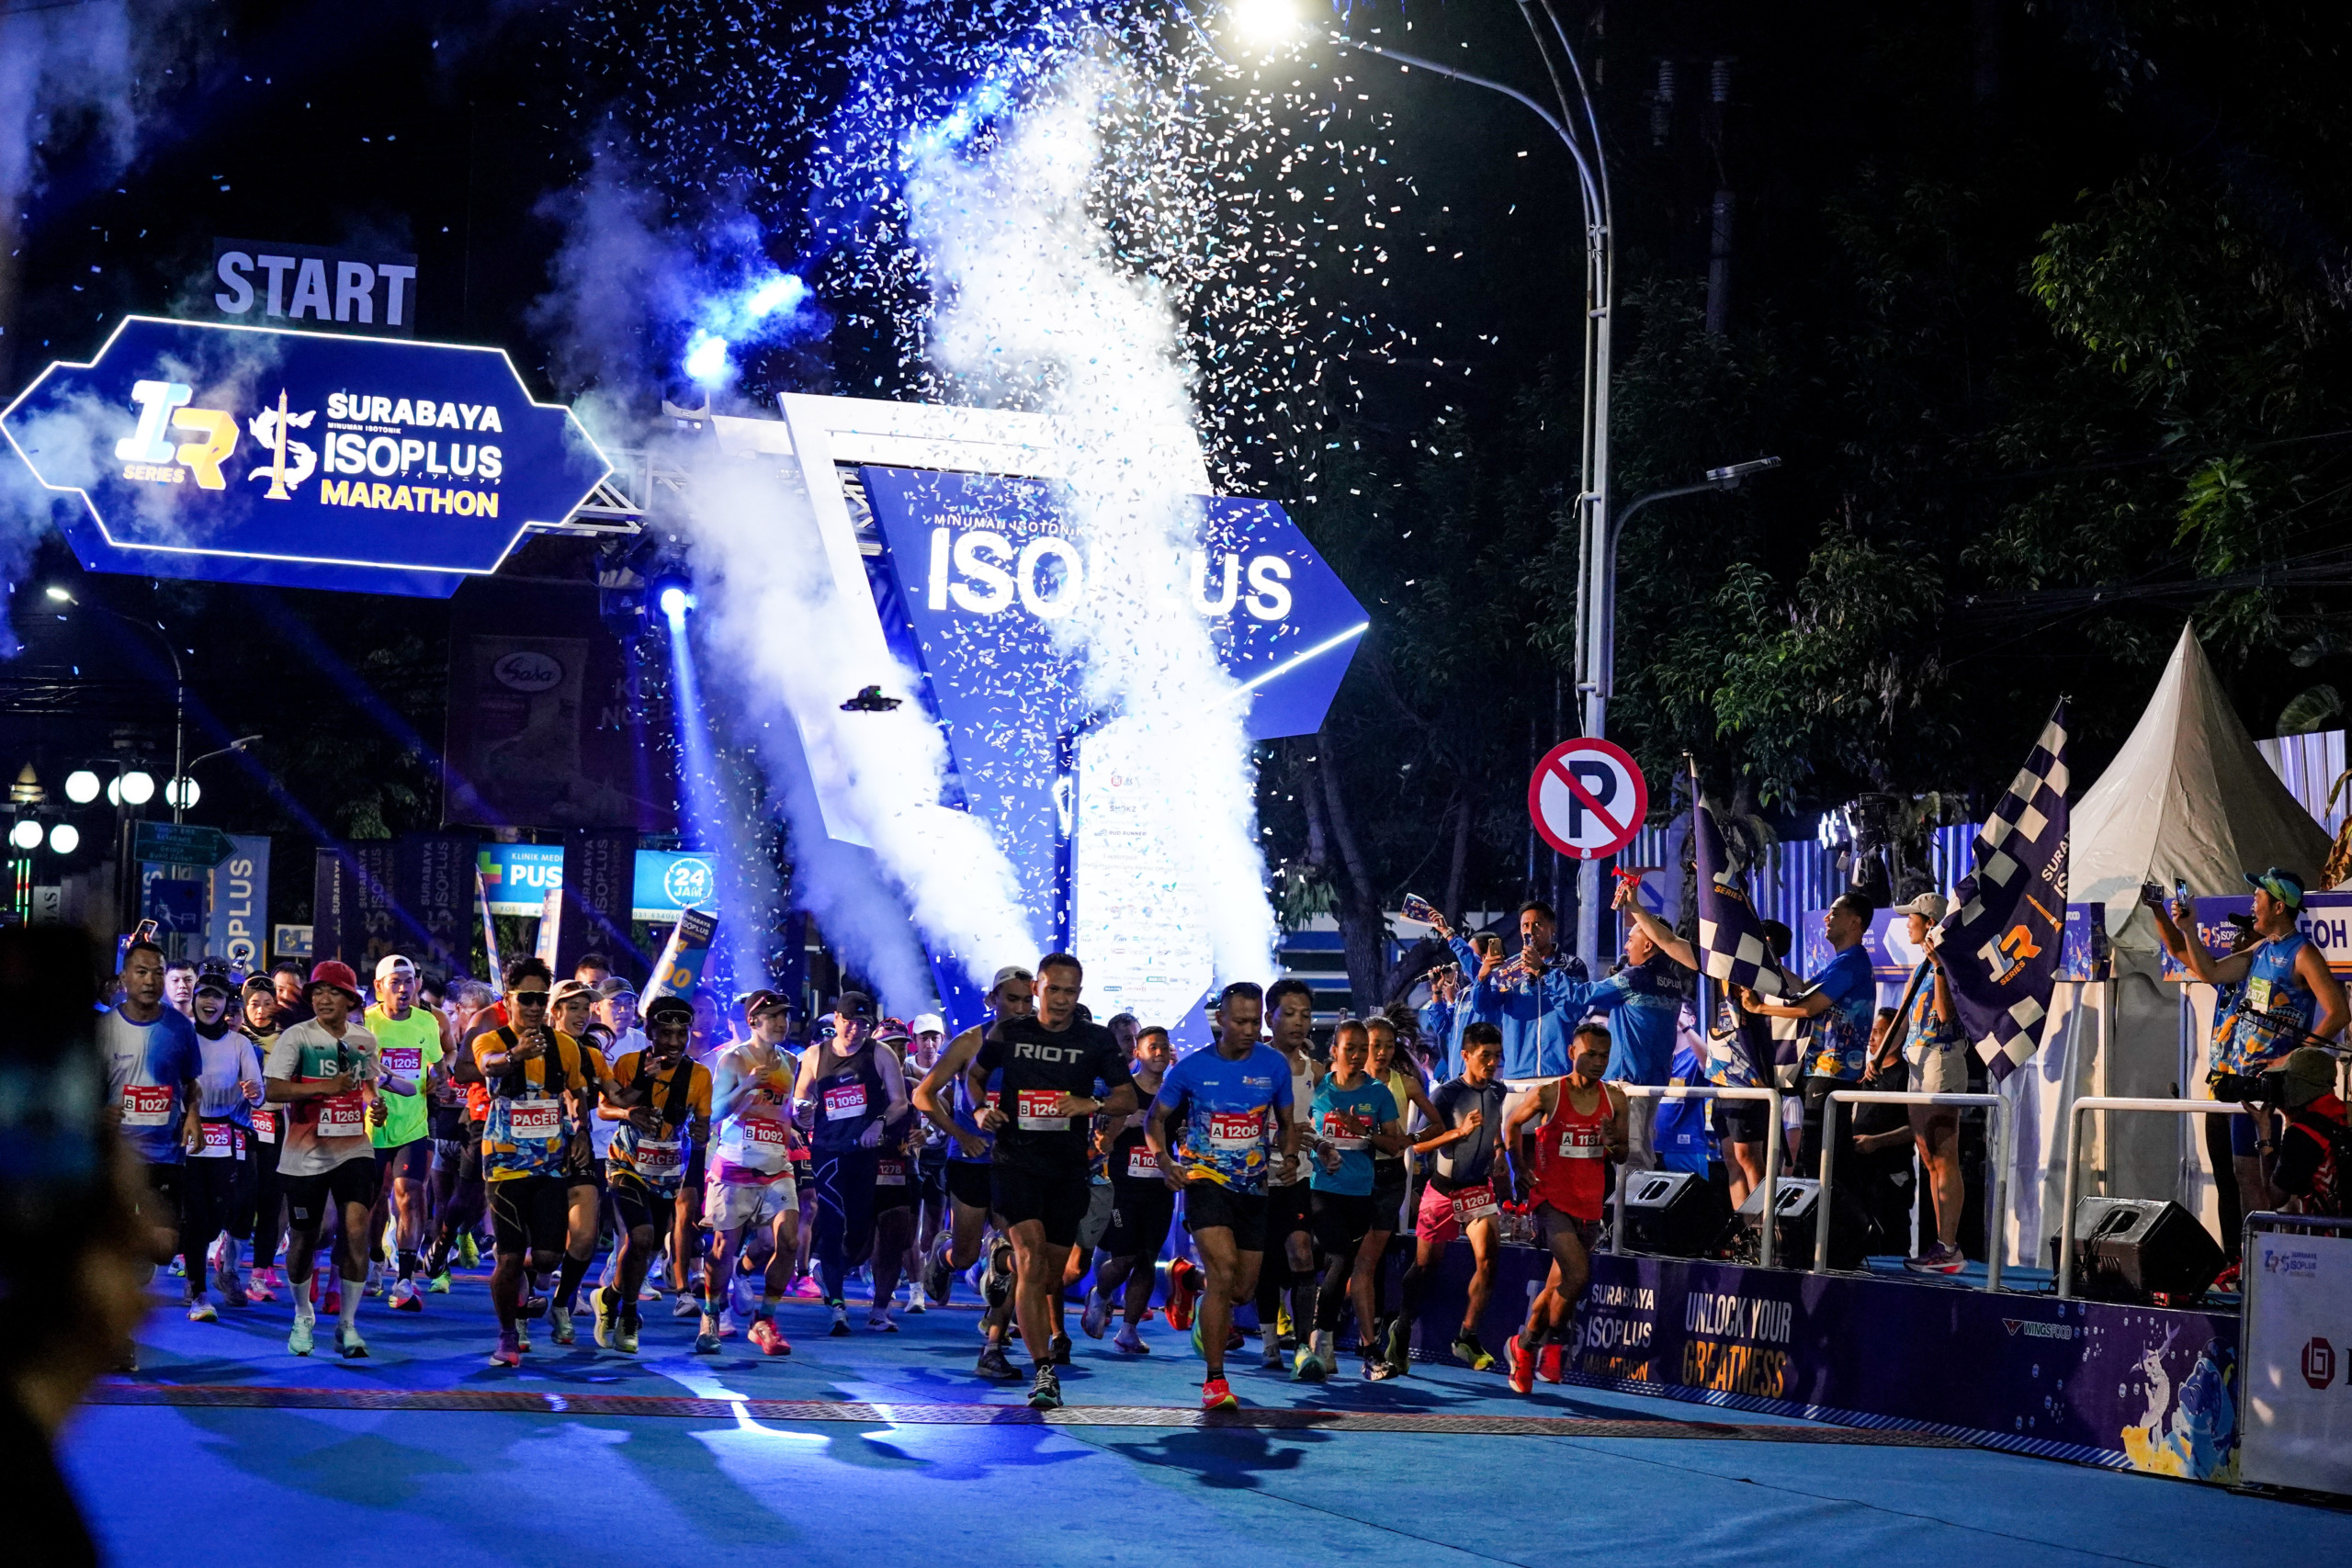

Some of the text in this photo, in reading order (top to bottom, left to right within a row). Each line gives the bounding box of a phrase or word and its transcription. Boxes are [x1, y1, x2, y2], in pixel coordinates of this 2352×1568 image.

[215, 251, 416, 326] START
[327, 392, 503, 433] SURABAYA
[327, 422, 401, 434] MINUMAN ISOTONIK
[323, 432, 503, 479] ISOPLUS
[123, 465, 186, 483] SERIES
[321, 479, 499, 518] MARATHON
[933, 513, 1006, 530] MINUMAN
[928, 527, 1292, 621] ISOUS
[1568, 761, 1617, 838] P
[512, 852, 538, 861] KLINIK
[359, 849, 368, 908] SURABAYA
[371, 848, 384, 908] ISOPLUS
[421, 841, 434, 907] SURABAYA
[435, 840, 449, 908] ISOPLUS
[510, 864, 563, 888] PUS
[581, 840, 594, 913] SURABAYA
[594, 840, 608, 914] ISOPLUS
[674, 868, 705, 887] 24
[673, 886, 704, 897] JAM
[1713, 885, 1743, 902] SERIES
[685, 913, 711, 929] URABAYA
[1999, 960, 2026, 986] SERIES
[1657, 976, 1682, 990] ISOPLUS
[1014, 1043, 1083, 1064] RIOT
[393, 1058, 419, 1068] 1205
[126, 1099, 170, 1111] B 1027
[836, 1094, 864, 1107] 1095
[1021, 1103, 1064, 1116] B 126
[253, 1119, 272, 1131] 065
[322, 1111, 361, 1122] A 1263
[513, 1113, 559, 1126] PACER
[204, 1134, 229, 1145] 025
[746, 1129, 784, 1143] B 1092
[1213, 1124, 1259, 1137] A 1206
[1326, 1126, 1333, 1135] A
[1563, 1134, 1601, 1145] A 1131
[638, 1152, 682, 1165] PACER
[1132, 1156, 1139, 1165] A
[878, 1165, 901, 1174] 1278
[1454, 1194, 1490, 1212] B 1267
[1591, 1283, 1654, 1311] SURABAYA
[1685, 1292, 1792, 1344] UNLOCK YOUR
[1586, 1315, 1653, 1349] ISOPLUS
[2023, 1321, 2073, 1340] WINGSFOOD
[1582, 1353, 1649, 1382] MARATHON
[1681, 1339, 1786, 1399] GREATNESS
